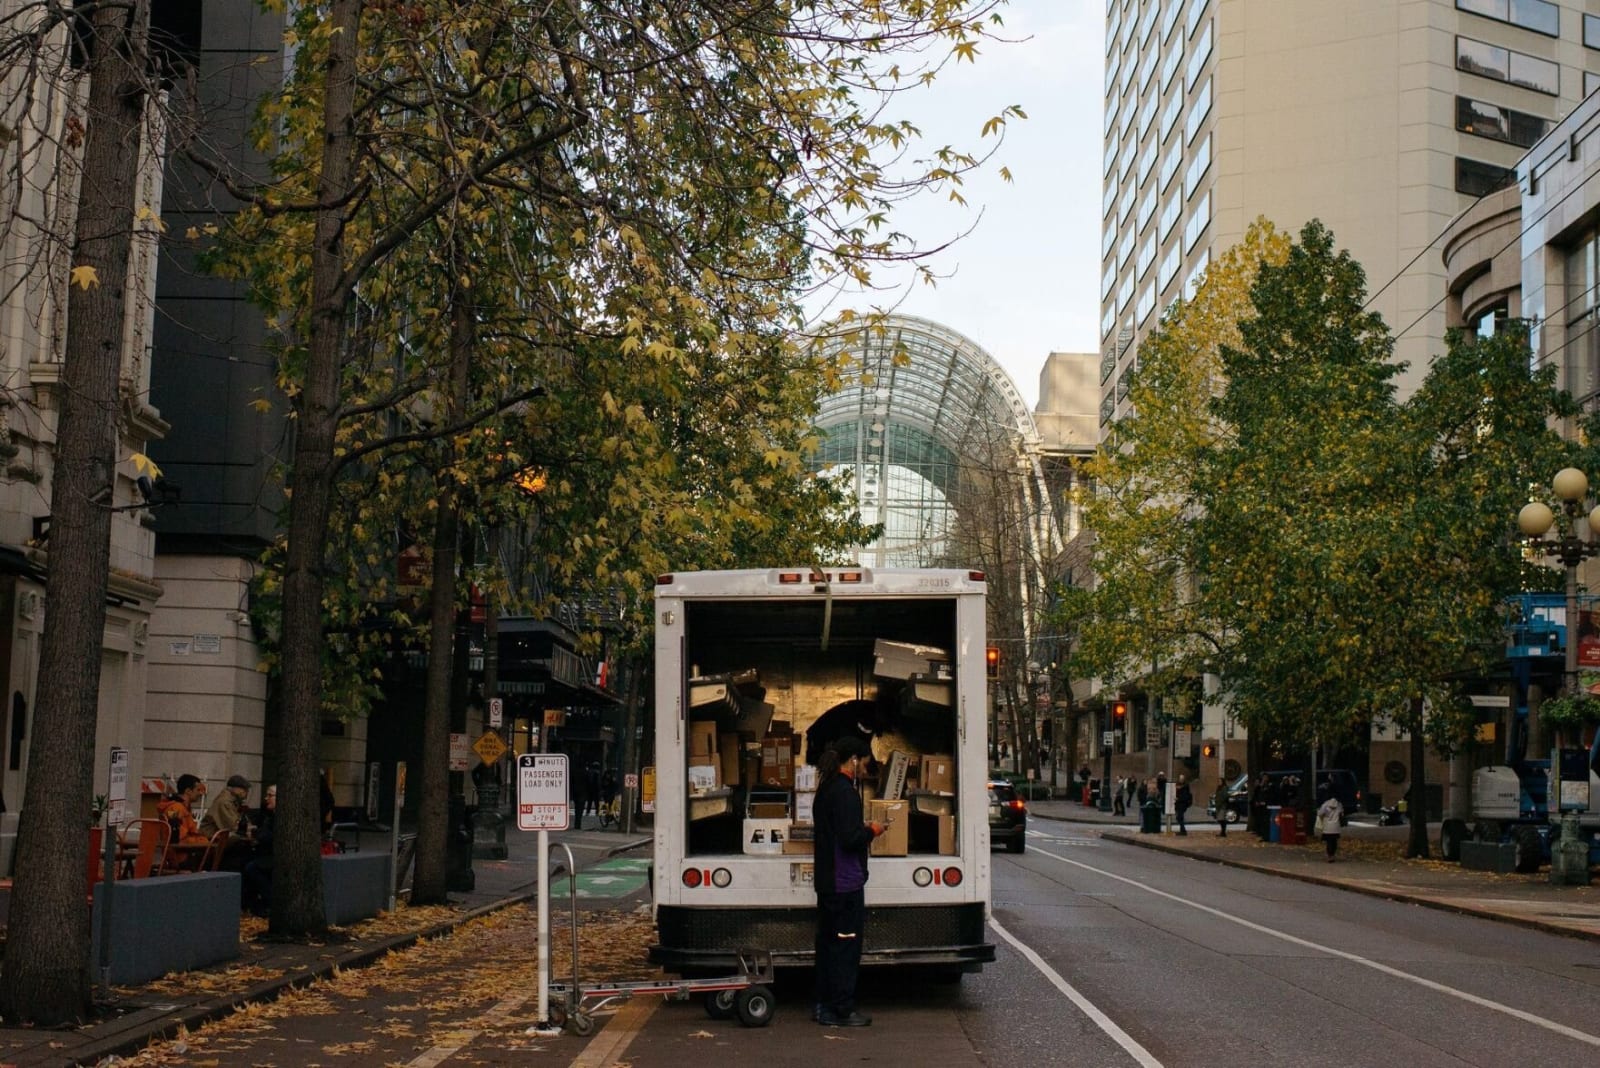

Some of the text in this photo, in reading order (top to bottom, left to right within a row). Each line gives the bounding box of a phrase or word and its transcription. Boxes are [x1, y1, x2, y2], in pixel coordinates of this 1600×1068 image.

[524, 757, 564, 767] 3 MINUTE
[524, 770, 563, 778] PASSENGER
[524, 780, 542, 788] LOAD
